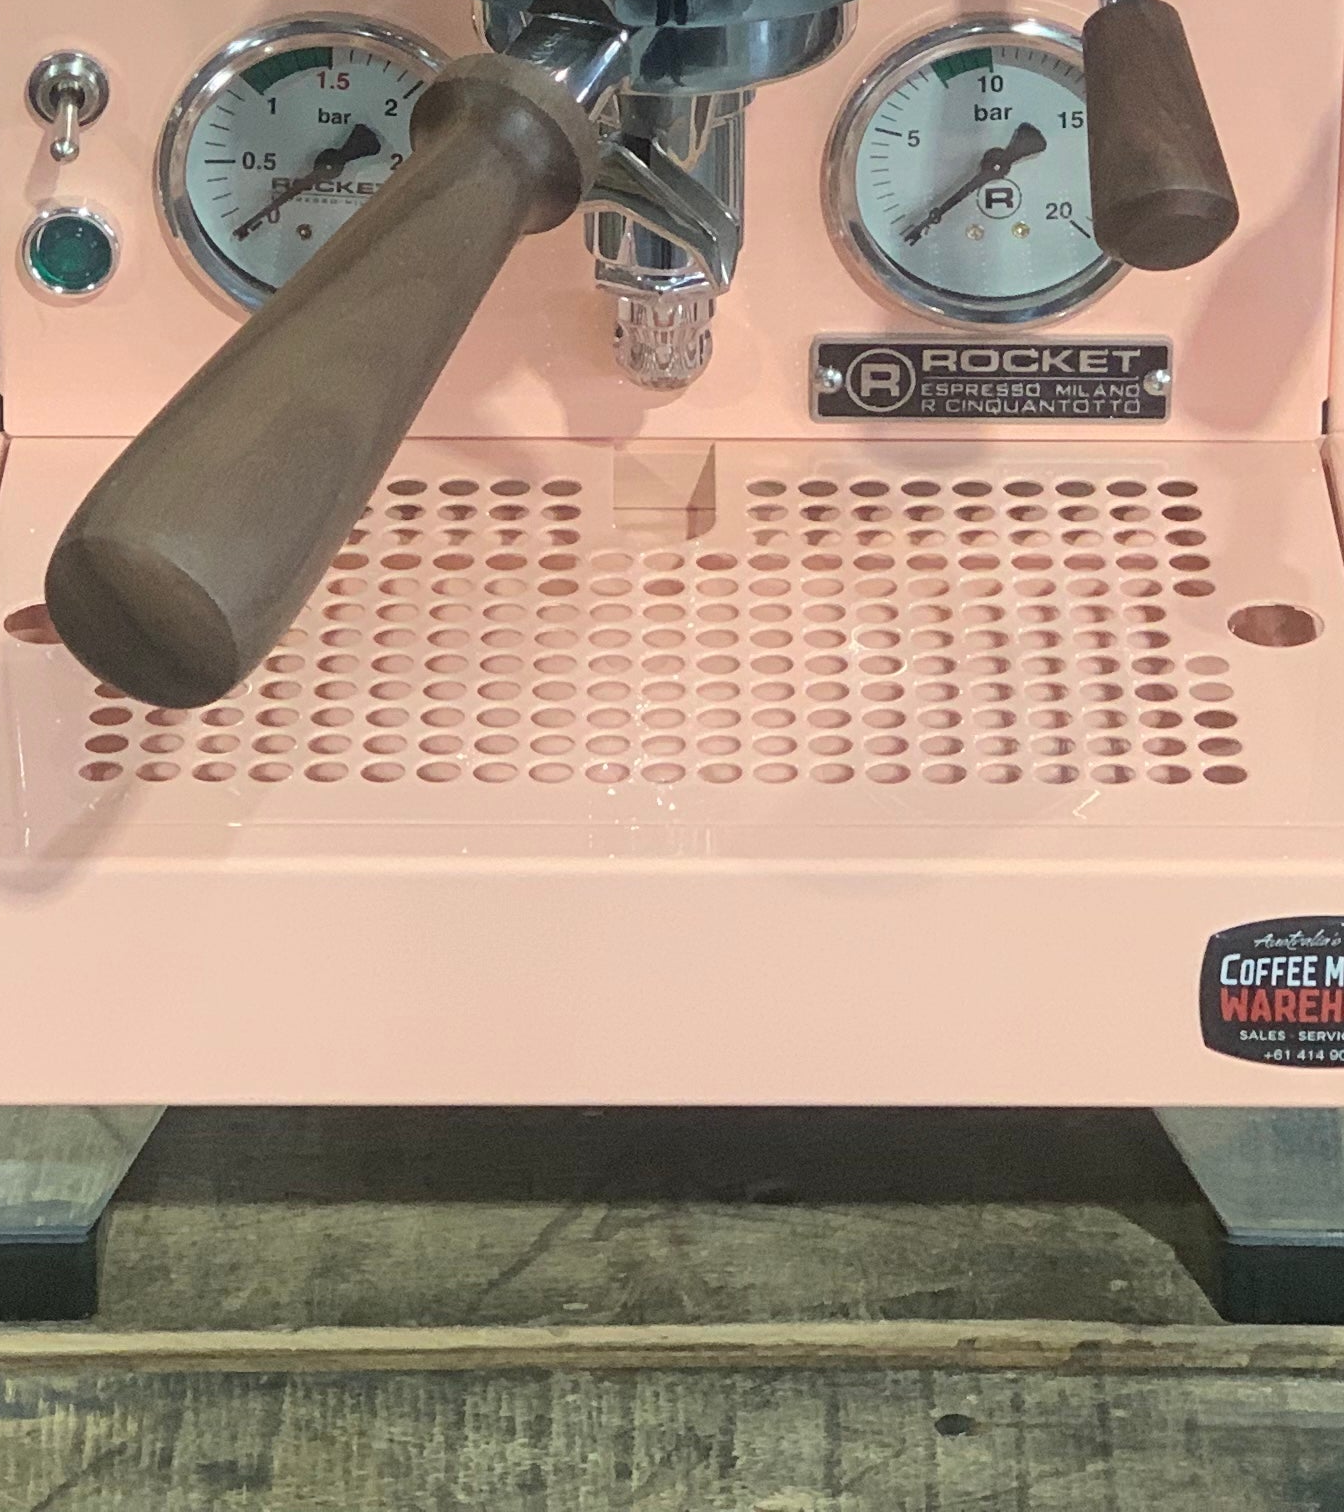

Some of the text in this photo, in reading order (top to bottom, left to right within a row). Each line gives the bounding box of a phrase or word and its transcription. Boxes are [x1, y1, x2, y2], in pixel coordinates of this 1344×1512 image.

[317, 72, 351, 91] 1.5
[977, 75, 1004, 93] 10
[267, 97, 277, 115] 1
[384, 98, 398, 117] 2
[974, 104, 1012, 122] bar
[318, 108, 352, 125] bar
[1057, 111, 1084, 129] 15
[907, 129, 921, 147] 5
[242, 152, 276, 171] 0.5
[1045, 201, 1072, 221] 20
[922, 349, 1142, 374] ROCKET
[860, 363, 901, 397] R
[921, 382, 1141, 397] ESPRESSO MILANO
[921, 398, 1141, 415] R CINQUANTOTTO
[1220, 953, 1318, 987] COFFEE
[1239, 1030, 1286, 1042] SALES
[1263, 1049, 1291, 1061] +61
[1297, 1049, 1325, 1062] 414
